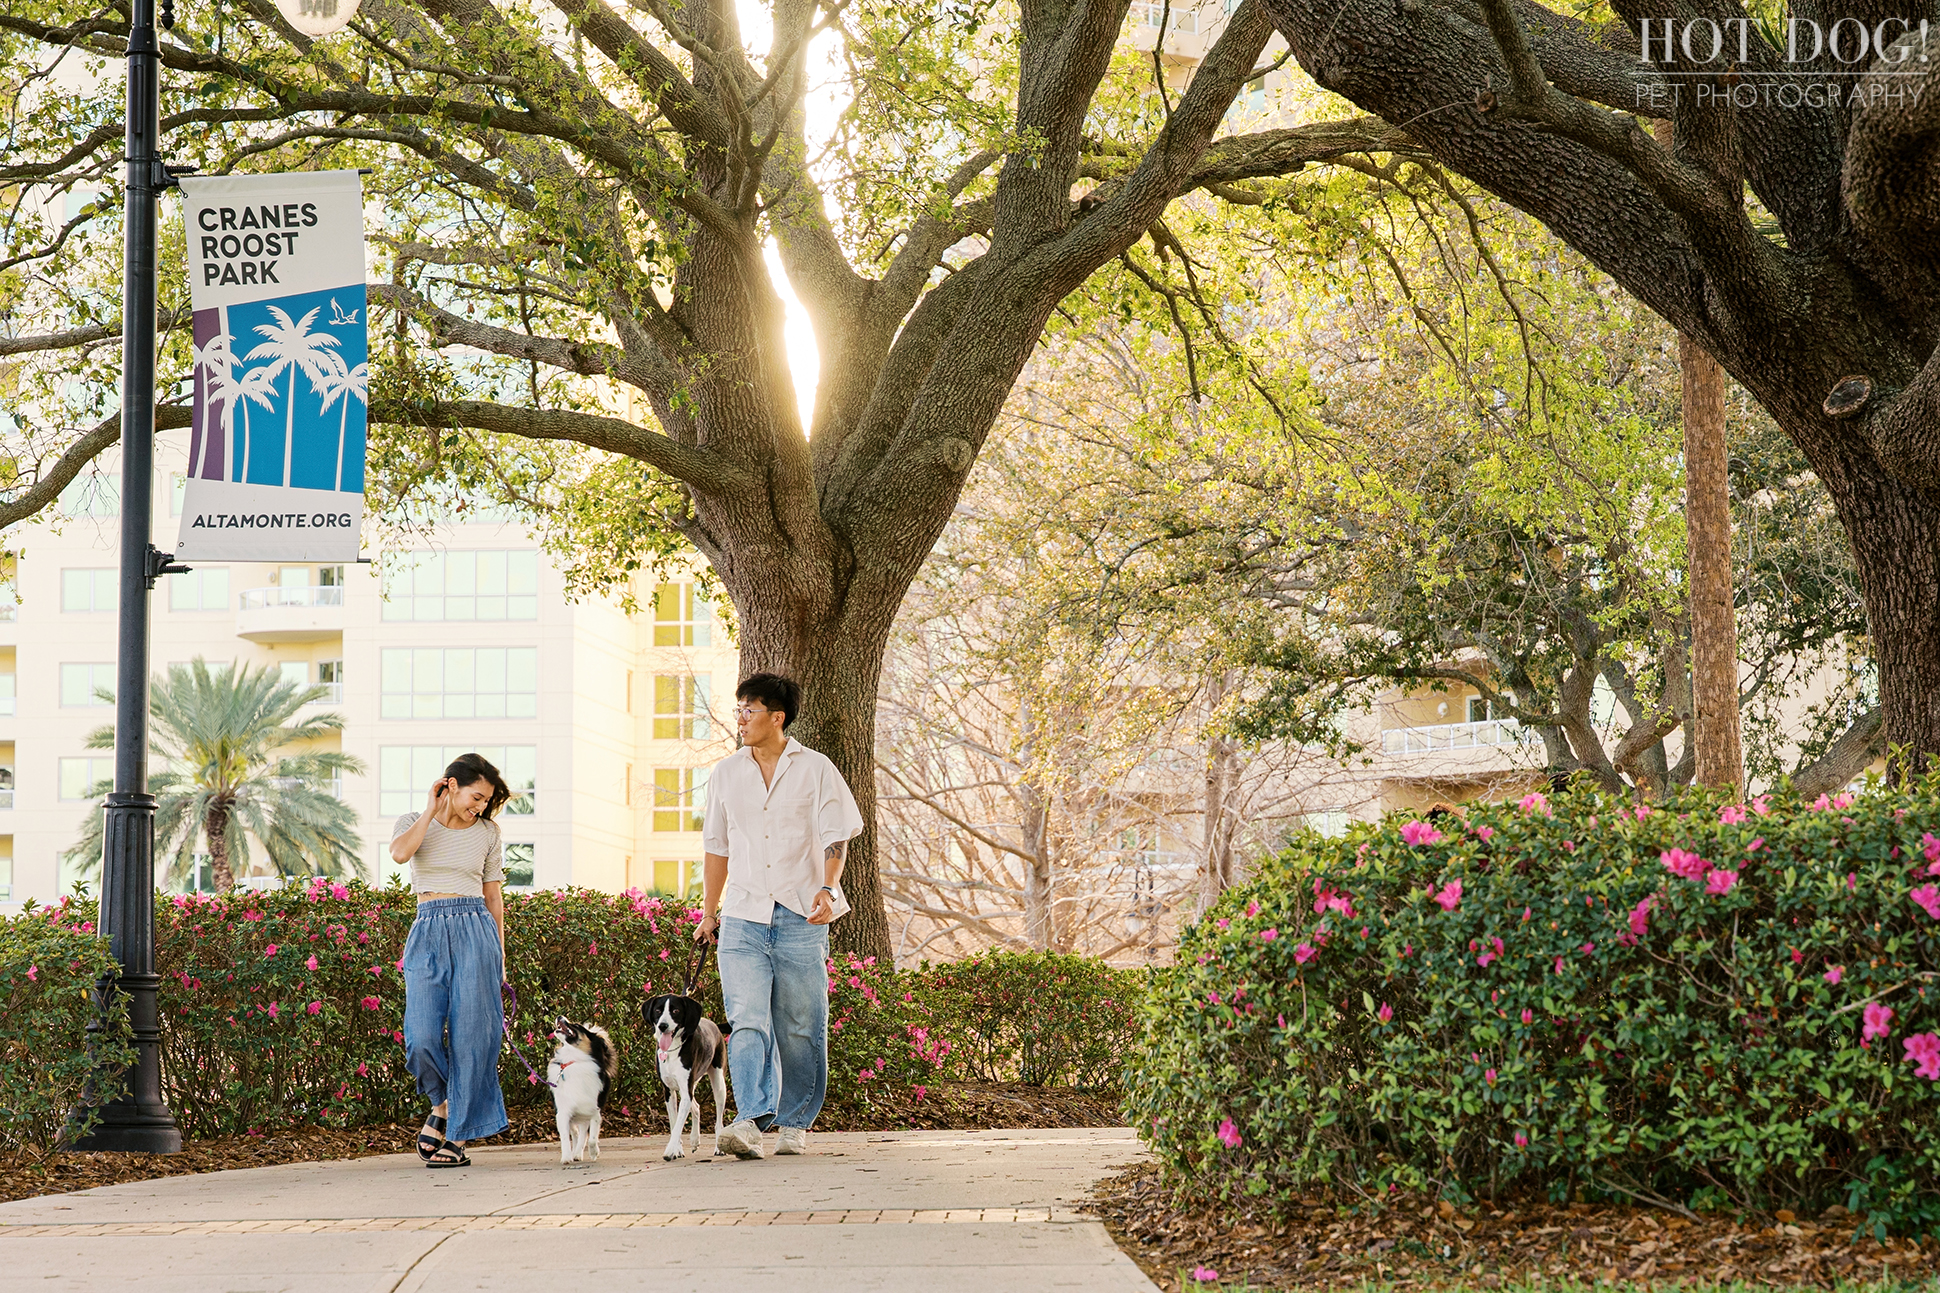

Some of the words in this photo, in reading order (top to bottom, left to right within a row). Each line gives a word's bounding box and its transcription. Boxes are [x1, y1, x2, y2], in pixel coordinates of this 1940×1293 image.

[198, 202, 318, 232] CRANES
[200, 232, 299, 259] ROOST
[204, 260, 280, 286] PARK
[192, 513, 352, 529] ALTAMONTE.ORG
